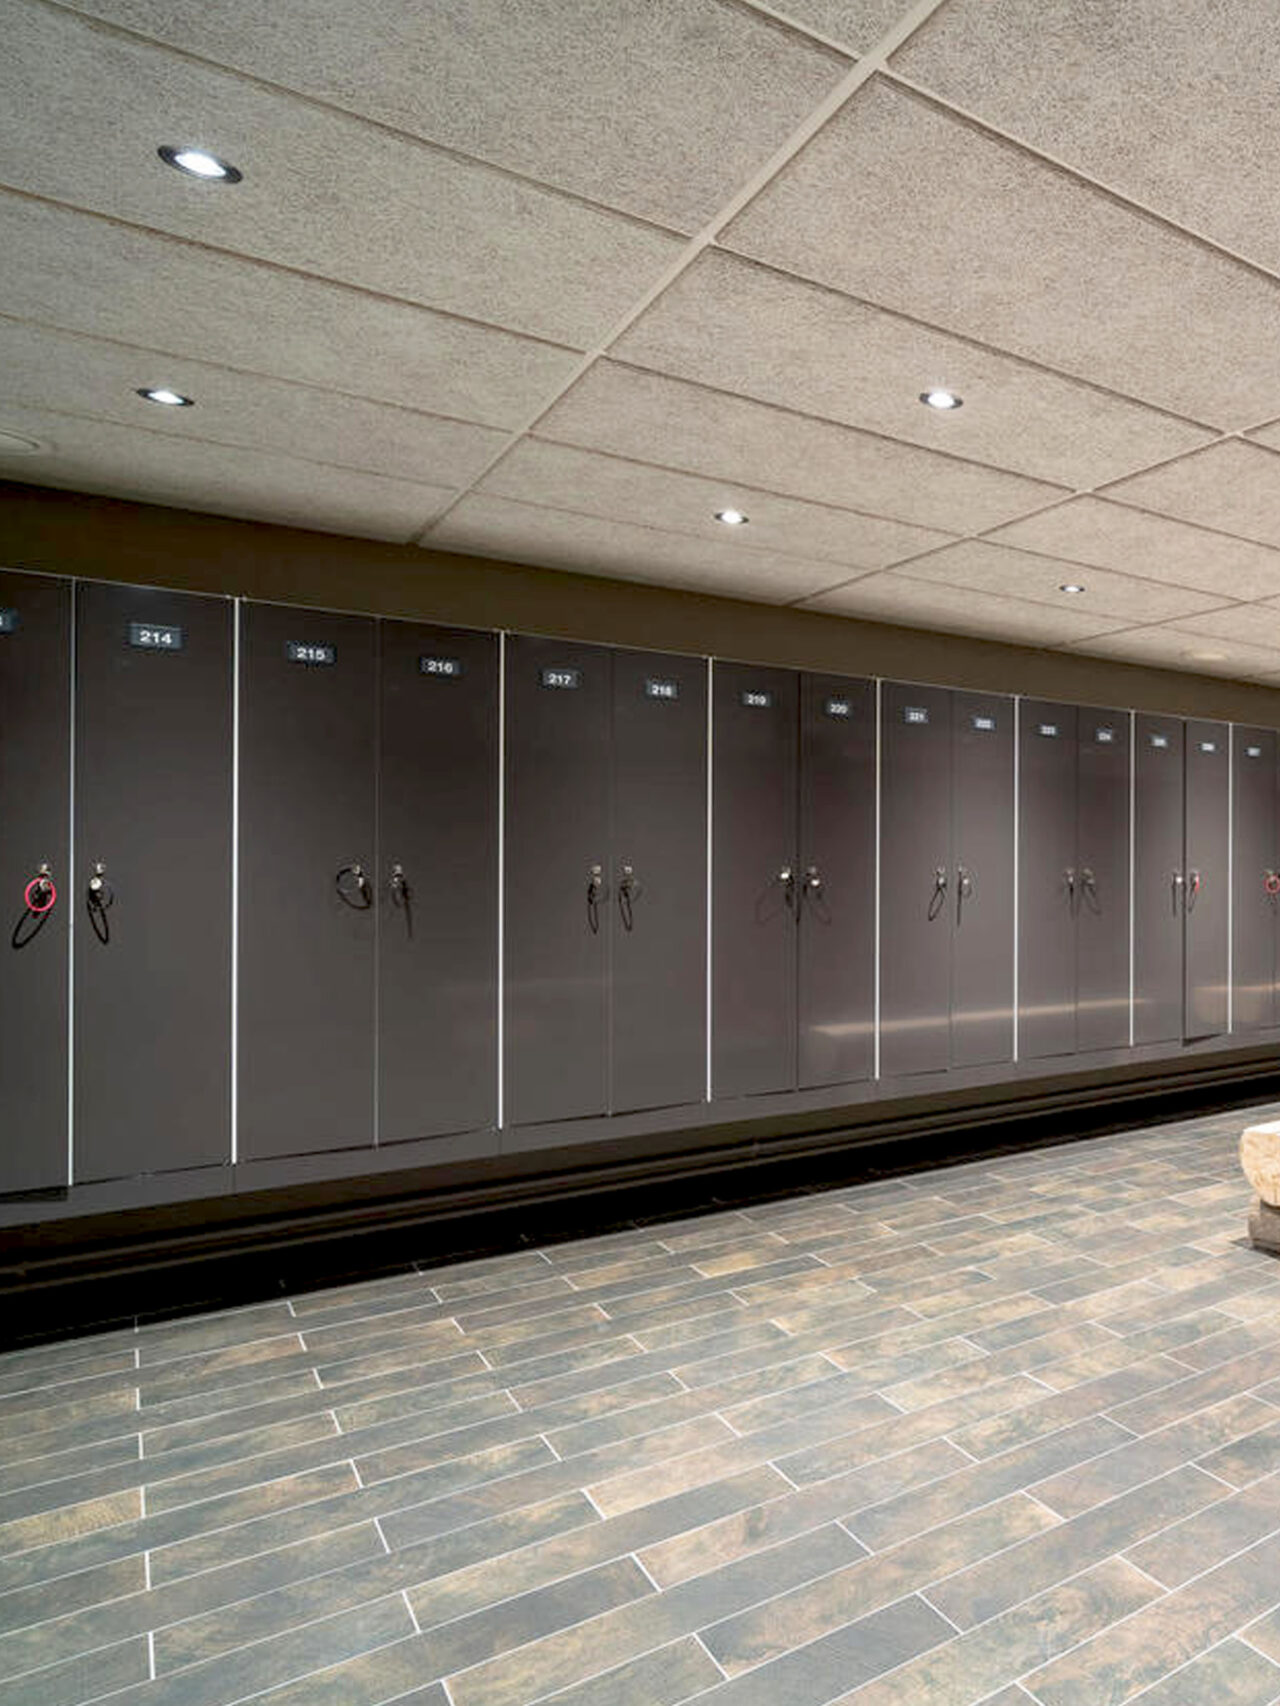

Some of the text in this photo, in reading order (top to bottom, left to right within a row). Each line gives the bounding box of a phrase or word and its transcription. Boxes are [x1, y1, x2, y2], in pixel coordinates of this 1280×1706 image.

[139, 630, 172, 644] 214
[297, 648, 325, 660] 215
[548, 673, 571, 685] 217
